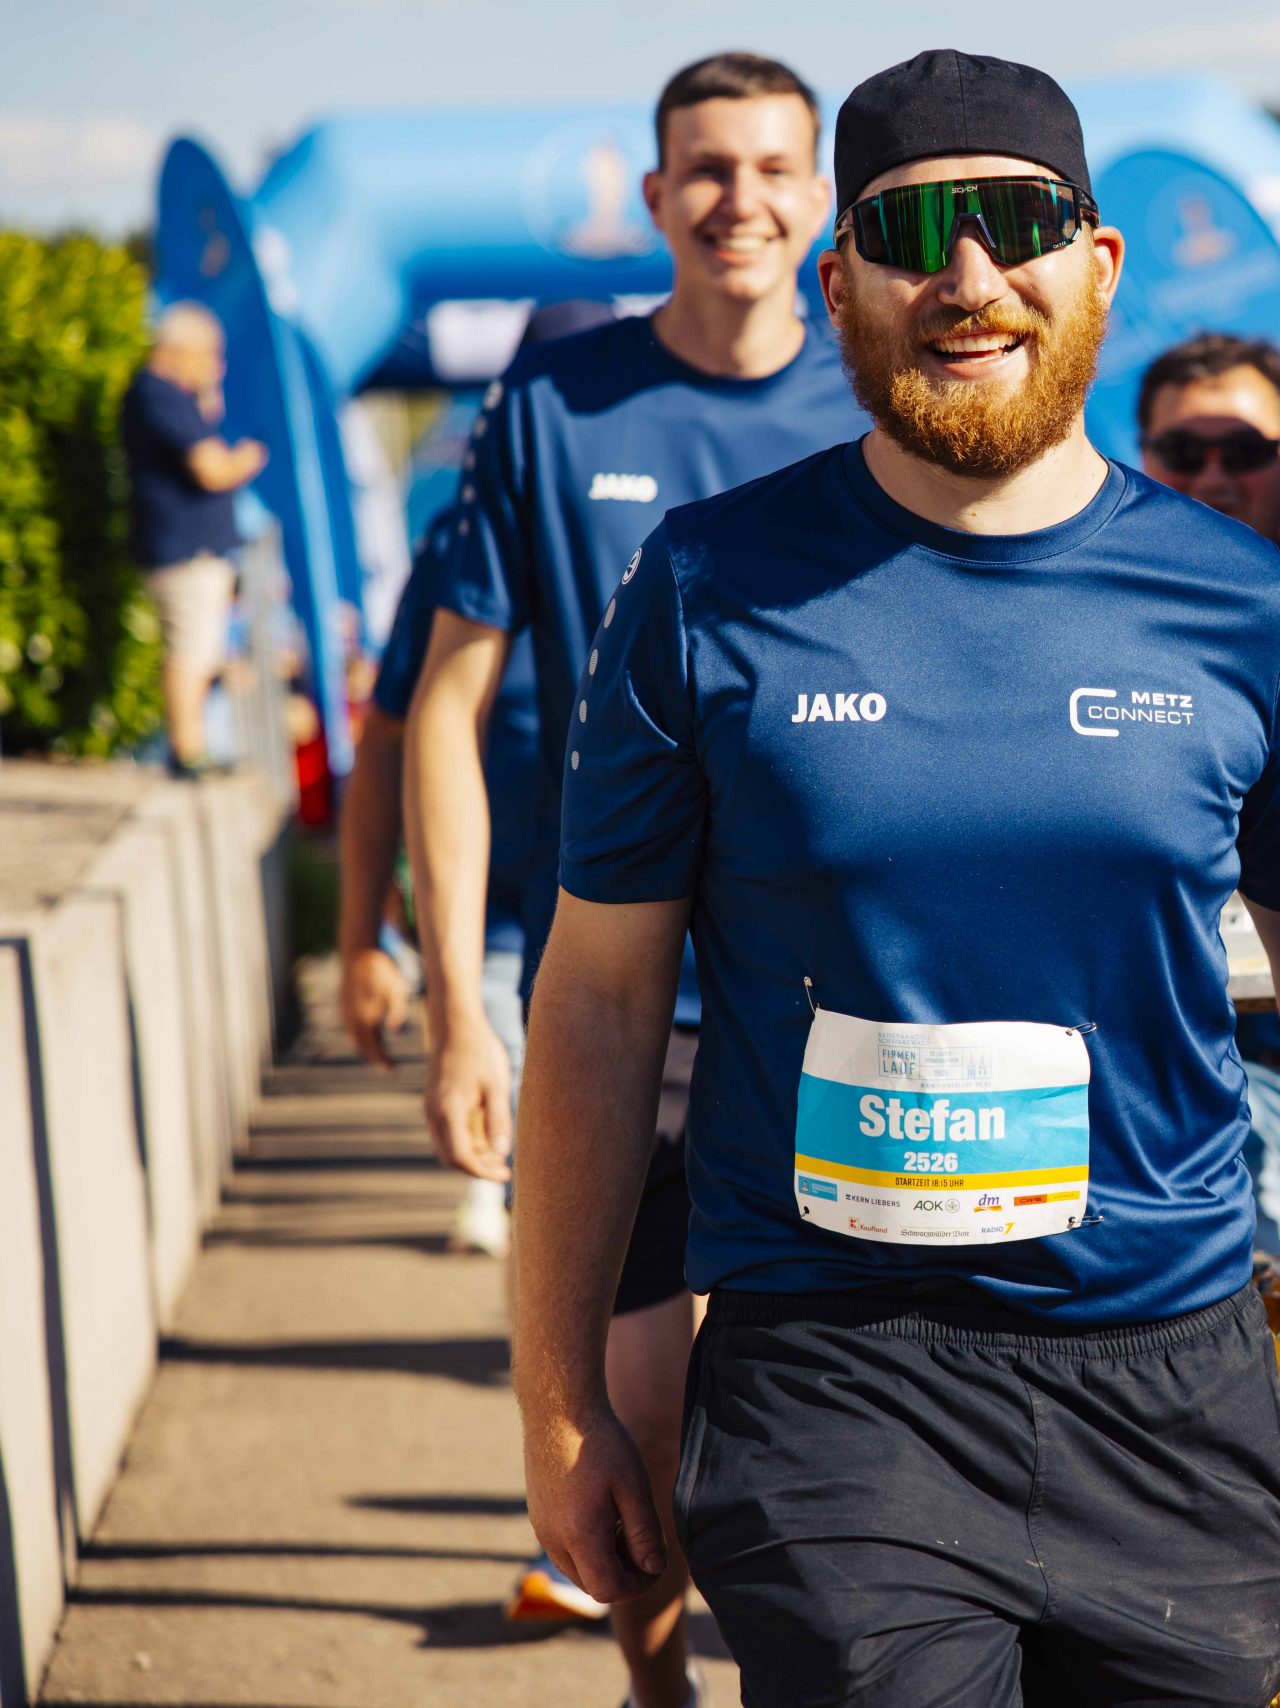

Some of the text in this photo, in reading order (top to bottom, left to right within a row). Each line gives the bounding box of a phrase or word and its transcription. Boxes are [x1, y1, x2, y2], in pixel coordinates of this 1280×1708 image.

[1131, 691, 1193, 708] METZ
[791, 692, 887, 723] JAKO
[1088, 705, 1195, 726] CONNECT
[882, 1049, 916, 1060] FIRMEN
[883, 1060, 916, 1075] LAUF
[859, 1094, 1006, 1142] Stefan
[903, 1151, 959, 1173] 2526
[895, 1177, 964, 1188] STARTZEIT 18:15 UHR
[852, 1195, 901, 1208] KERN LIEBERS
[913, 1200, 943, 1211] AOK
[978, 1193, 999, 1206] dm
[860, 1224, 888, 1234] Kaufland
[981, 1222, 1015, 1235] RADIO 7
